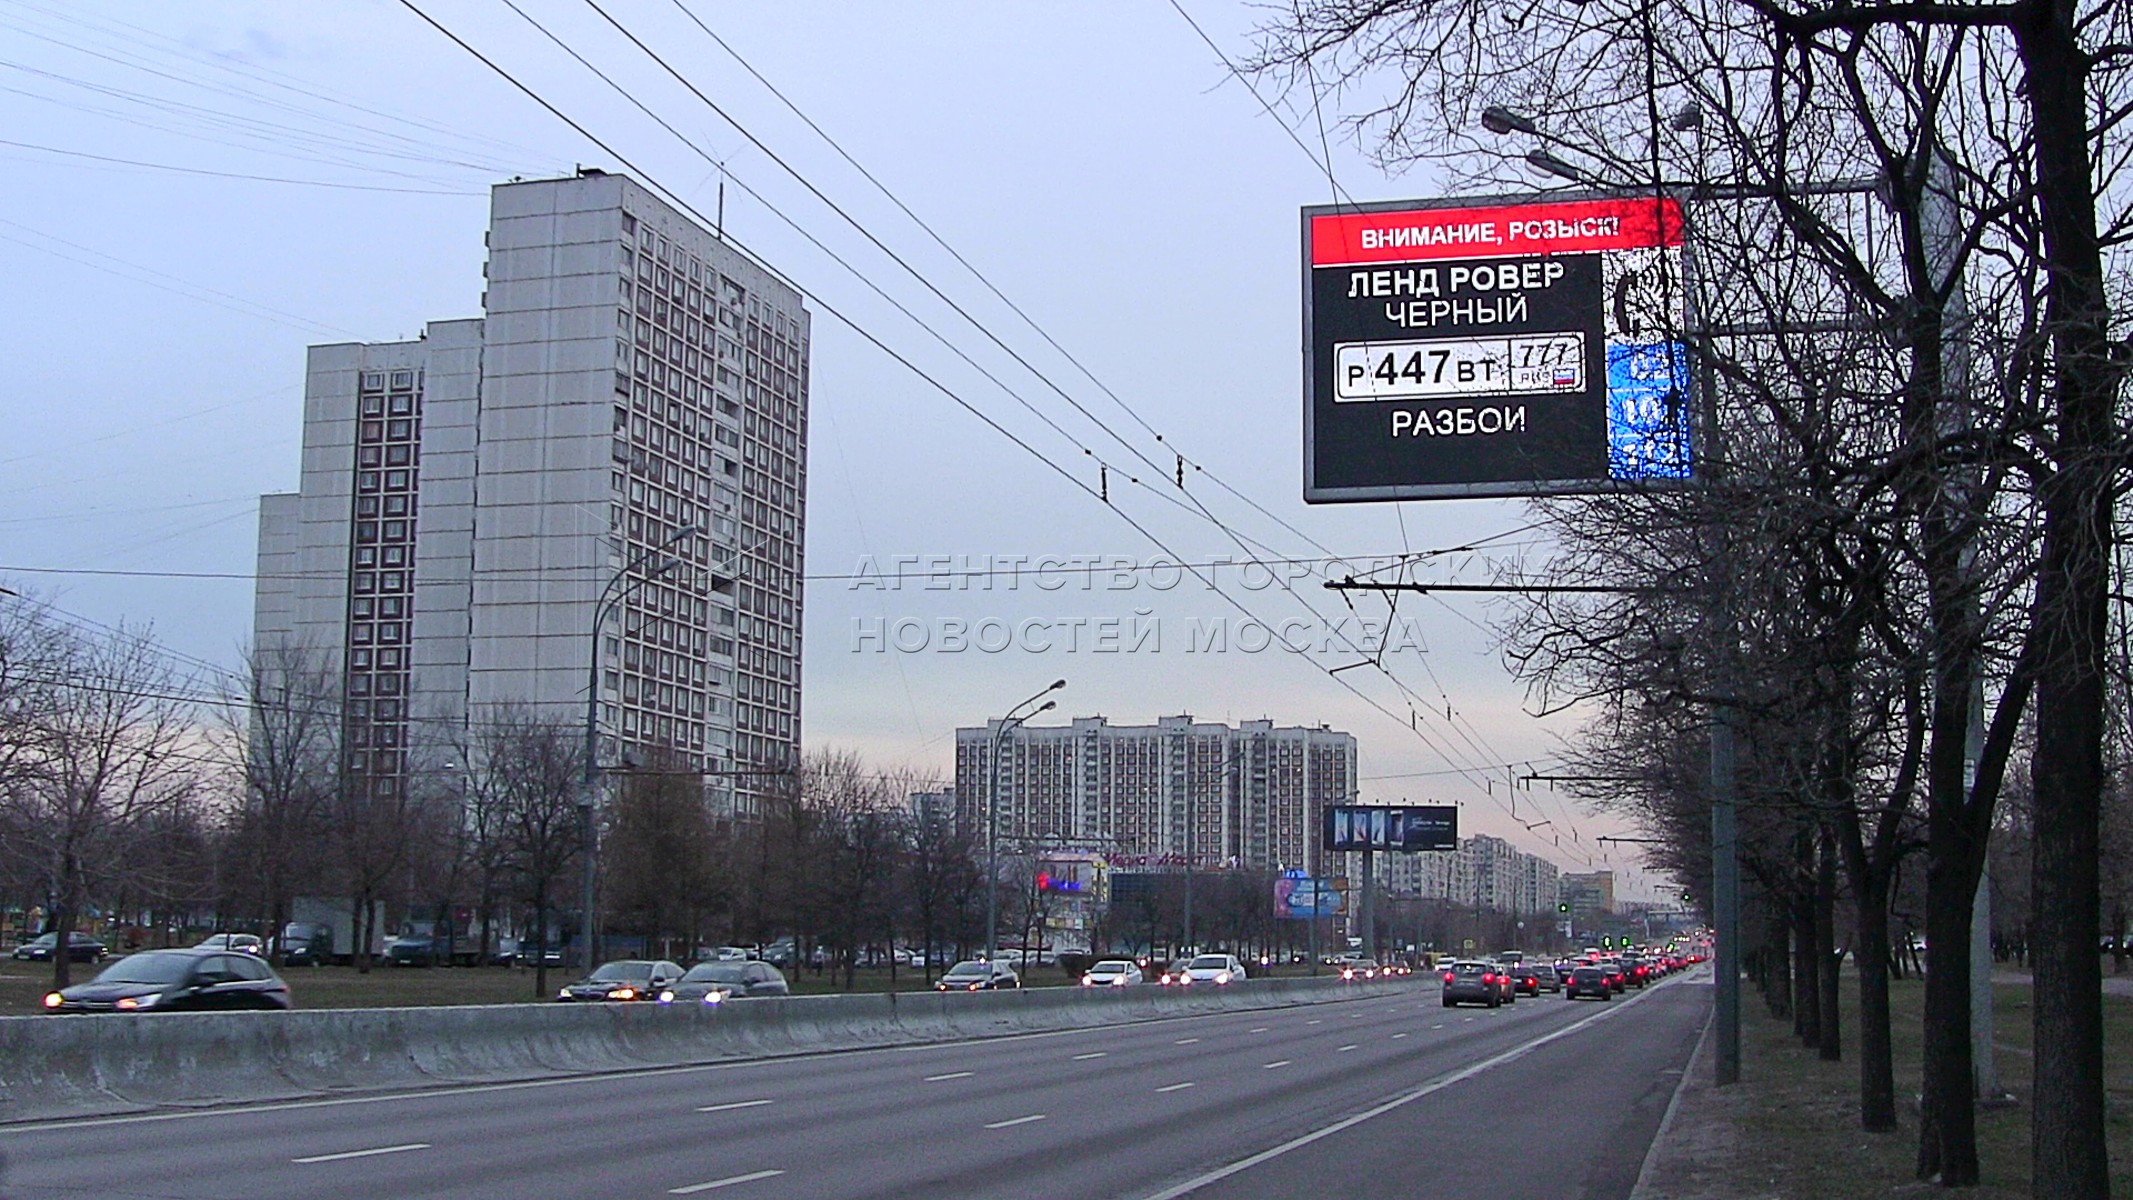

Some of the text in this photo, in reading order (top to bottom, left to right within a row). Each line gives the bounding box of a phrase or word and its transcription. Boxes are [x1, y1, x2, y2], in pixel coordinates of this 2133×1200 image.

[1361, 216, 1619, 249] ВНИМАНИЕ, РОЗЫСК!
[1348, 262, 1564, 298] ЛЕНД РОВЕР
[1385, 291, 1527, 328] ЧЕРНЫЙ
[1520, 340, 1568, 367] 777
